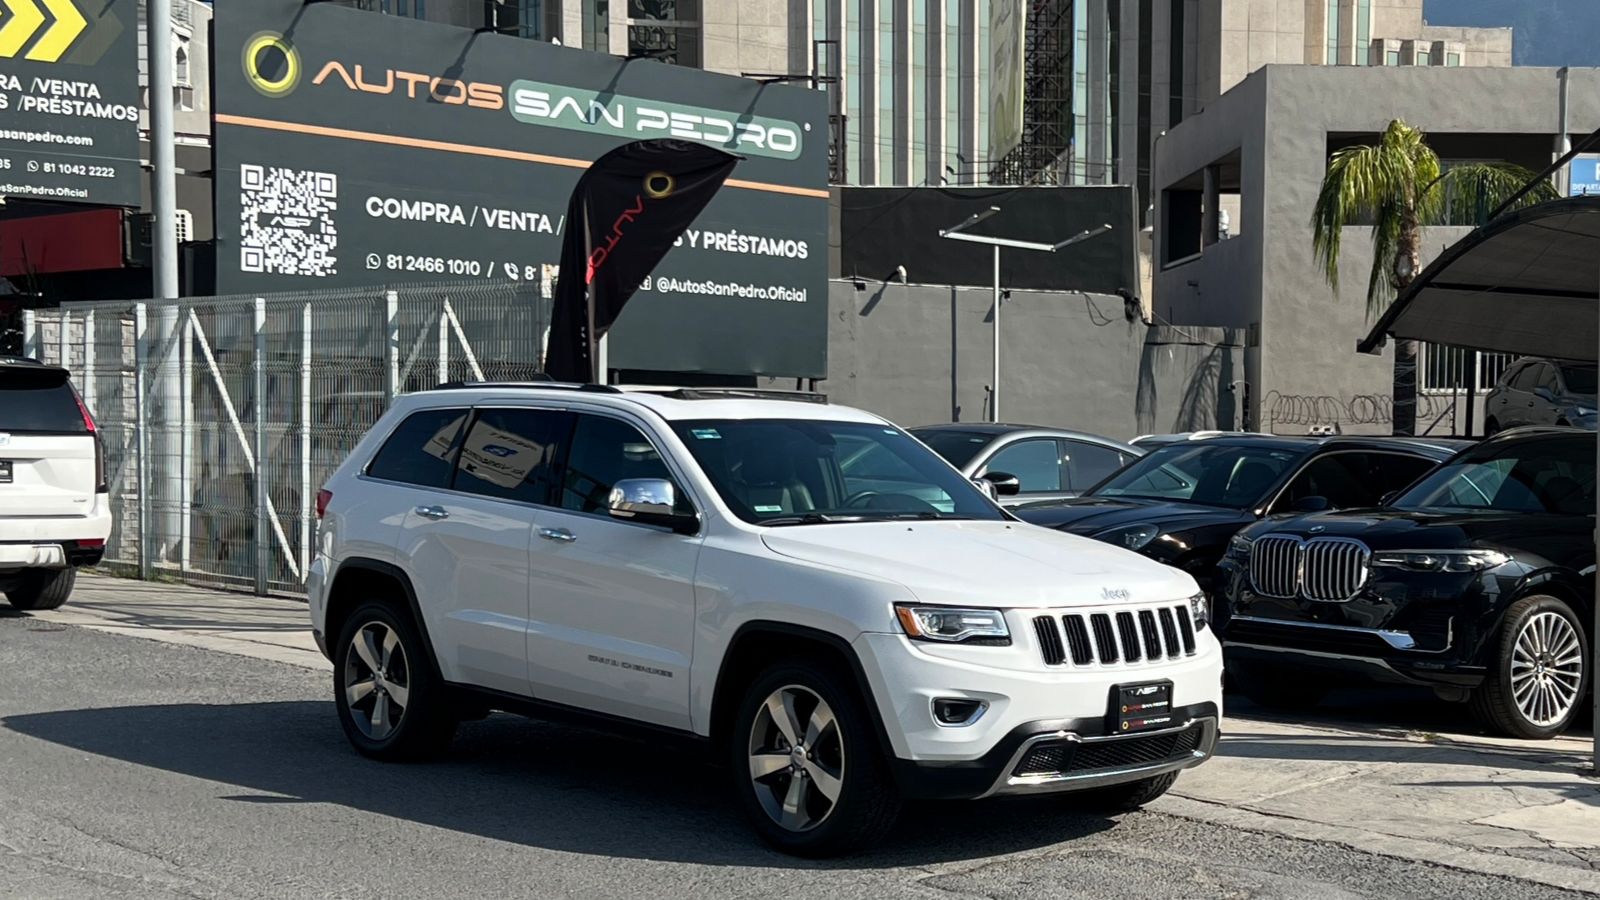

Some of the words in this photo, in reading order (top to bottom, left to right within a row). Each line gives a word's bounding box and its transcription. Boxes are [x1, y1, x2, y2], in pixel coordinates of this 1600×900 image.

[312, 60, 504, 111] AUTOS
[514, 87, 625, 129] SAN
[636, 106, 798, 153] PEDRO
[43, 162, 56, 173] 81
[58, 163, 86, 176] 1042
[88, 166, 115, 178] 2222
[365, 196, 467, 226] COMPRA
[481, 207, 553, 234] VENTA
[686, 229, 700, 248] Y
[703, 229, 808, 259] PRÉSTAMOS
[386, 254, 403, 270] 81
[405, 255, 445, 273] 2466
[448, 259, 481, 276] 1010
[656, 276, 807, 302] @AutosSanPedro.Oficial
[1100, 587, 1130, 601] Jeep
